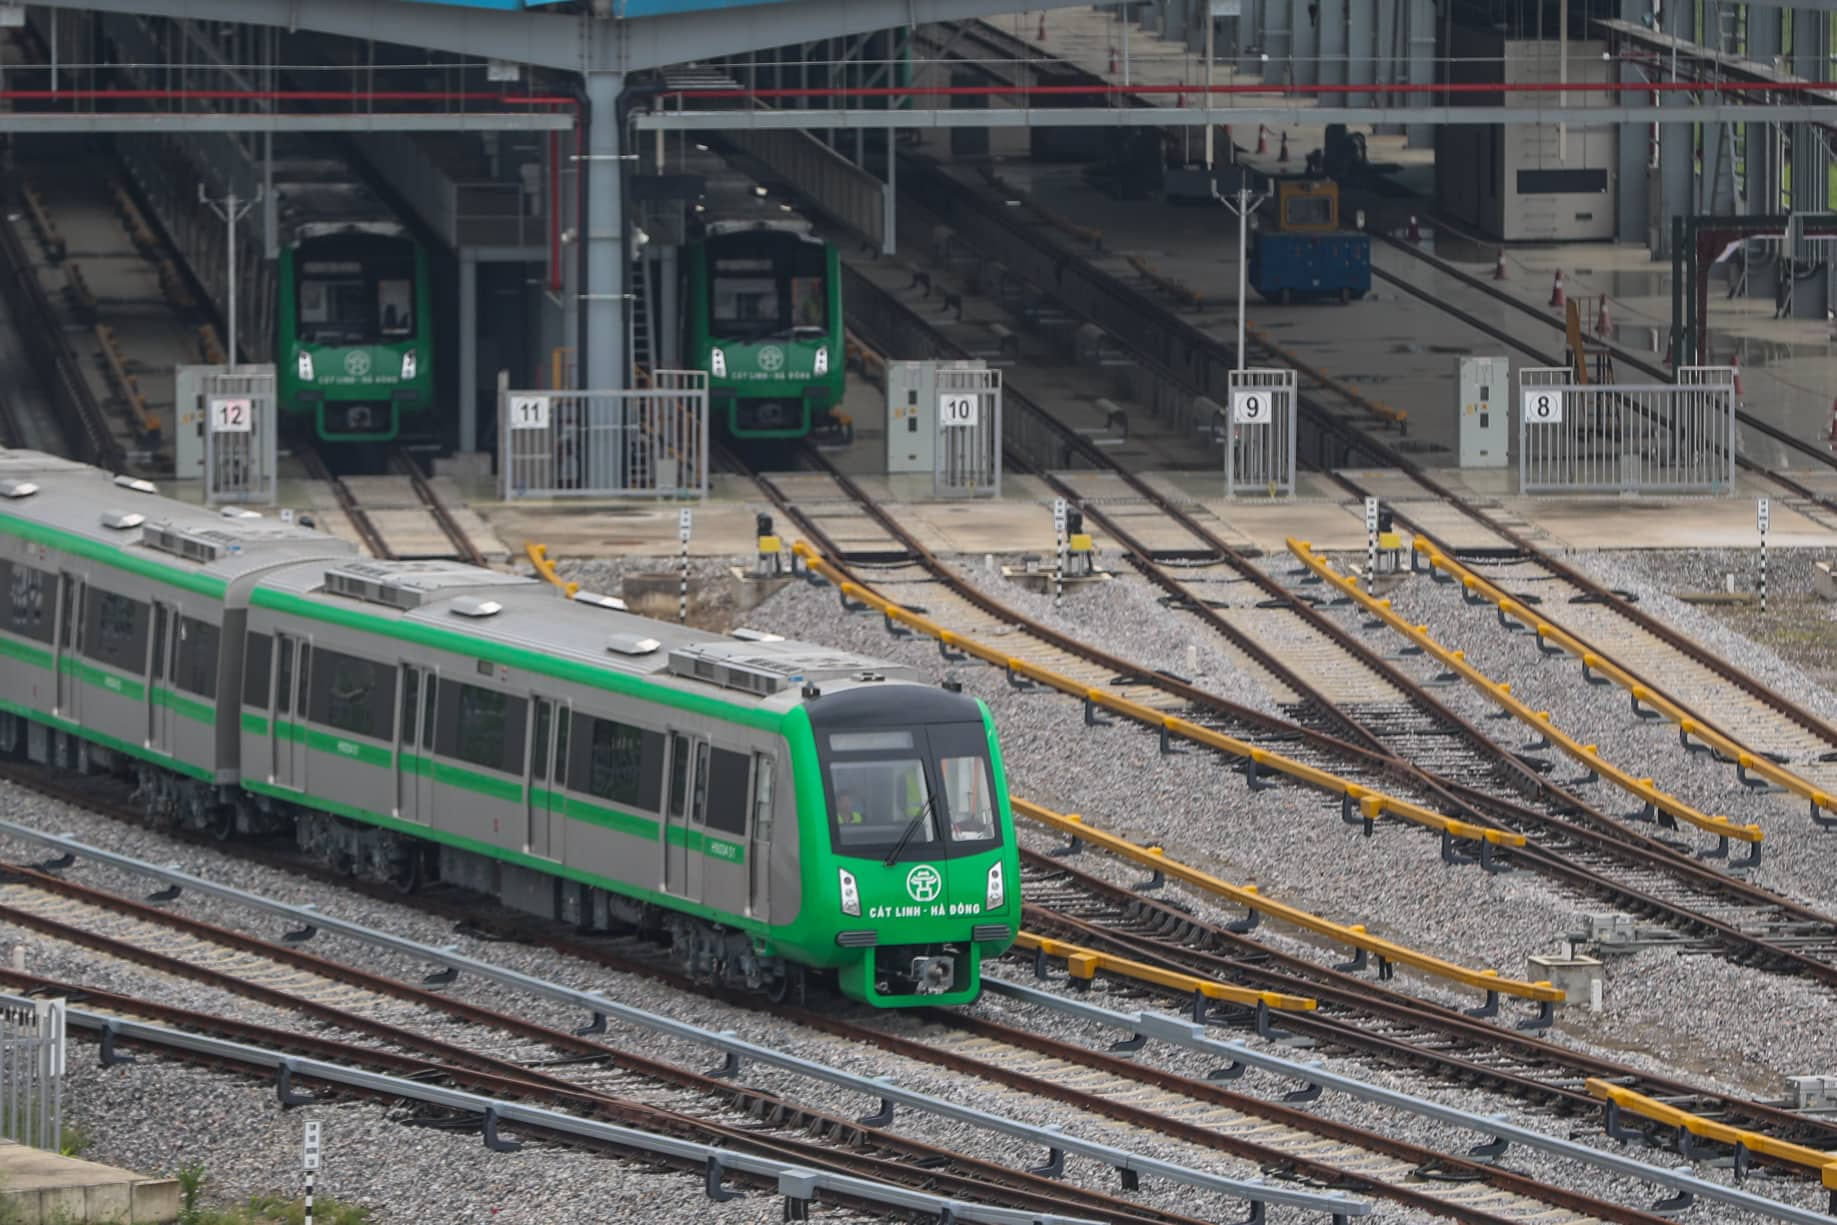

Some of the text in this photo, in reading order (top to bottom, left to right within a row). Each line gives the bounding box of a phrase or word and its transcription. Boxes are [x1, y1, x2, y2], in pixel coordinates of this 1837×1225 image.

[220, 406, 242, 424] 12
[520, 402, 539, 421] 11
[949, 400, 969, 419] 10
[1247, 396, 1258, 418] 9
[1538, 396, 1550, 417] 8
[895, 906, 921, 917] LINH
